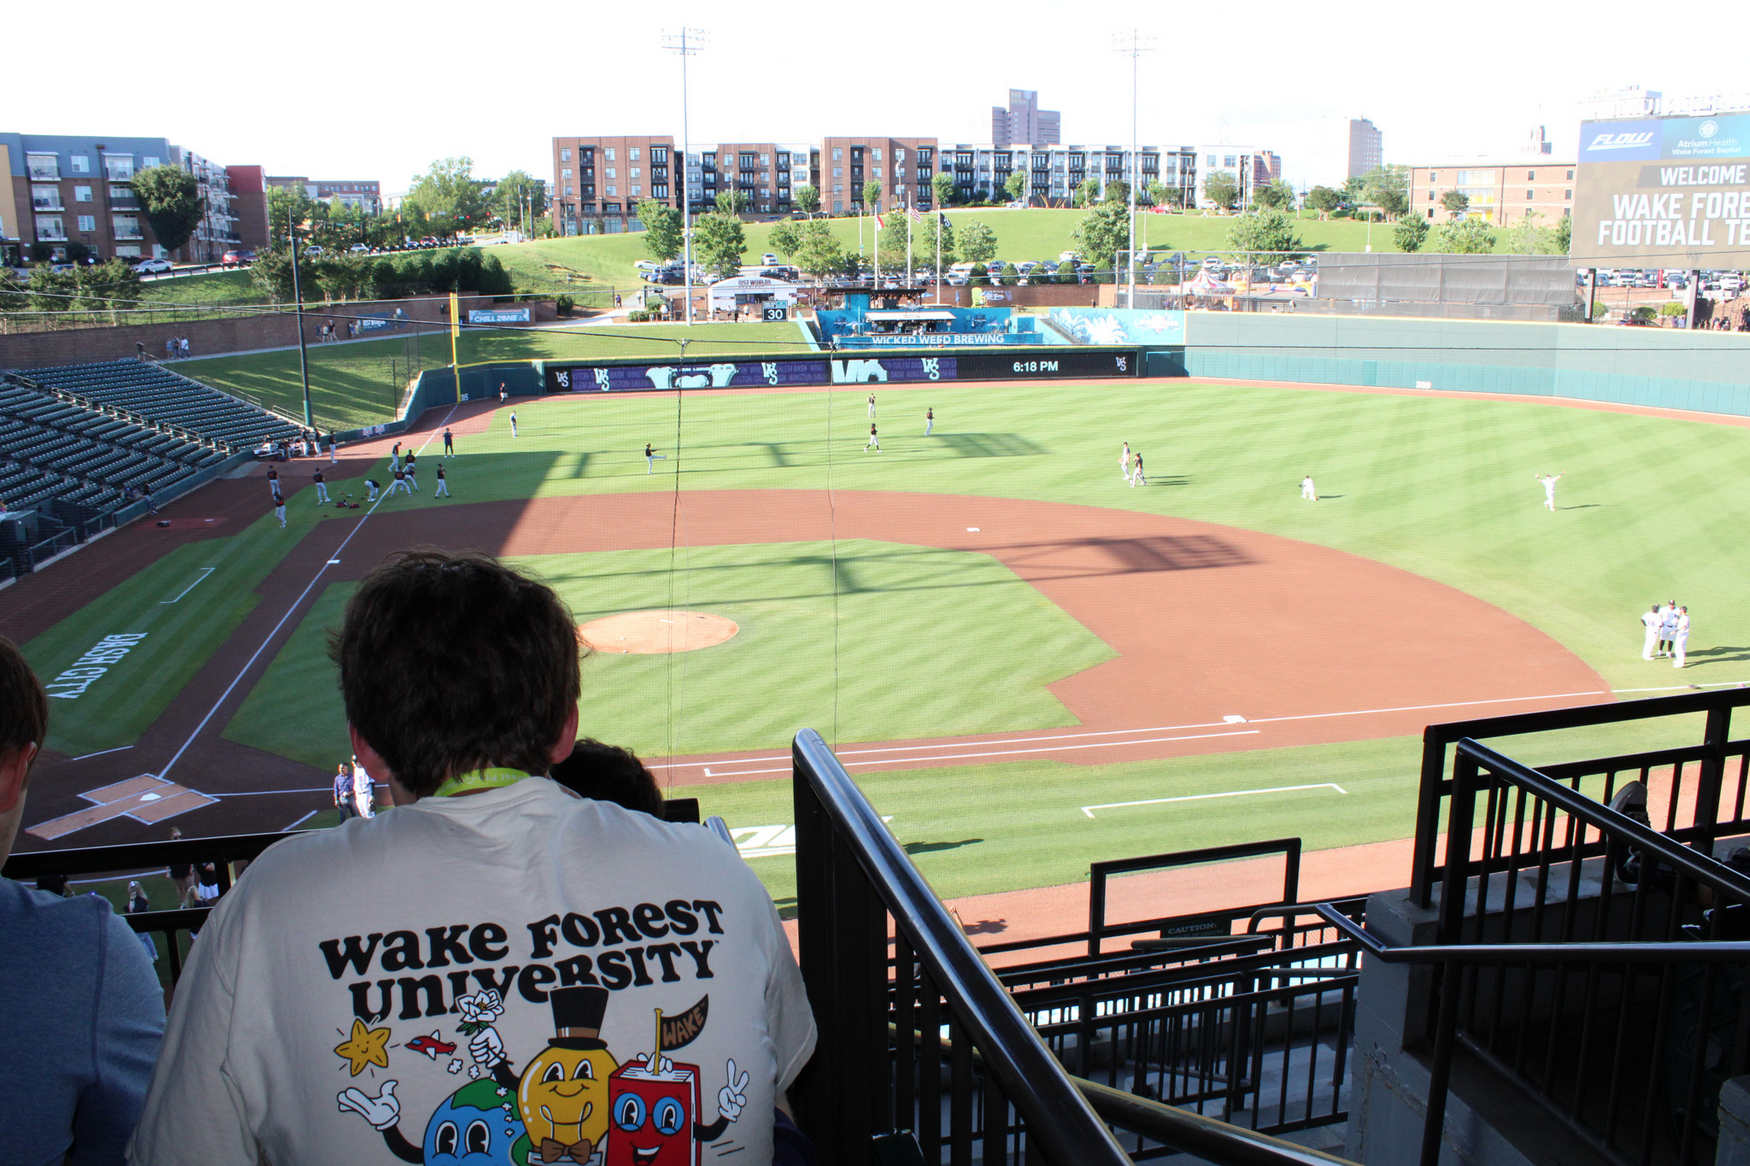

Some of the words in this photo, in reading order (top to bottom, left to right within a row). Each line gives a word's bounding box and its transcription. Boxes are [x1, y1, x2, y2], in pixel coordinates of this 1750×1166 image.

[1591, 131, 1654, 145] FLOW
[1660, 166, 1746, 186] WELCOME
[1612, 193, 1684, 220] WAKE
[1597, 219, 1716, 246] FOOTBALL
[767, 309, 783, 319] 30
[872, 336, 917, 345] WICKED
[919, 335, 951, 344] WEED
[953, 334, 1005, 344] BREWING
[1013, 361, 1038, 373] 6:18
[1039, 360, 1059, 372] PM
[662, 1006, 705, 1048] WAKE
